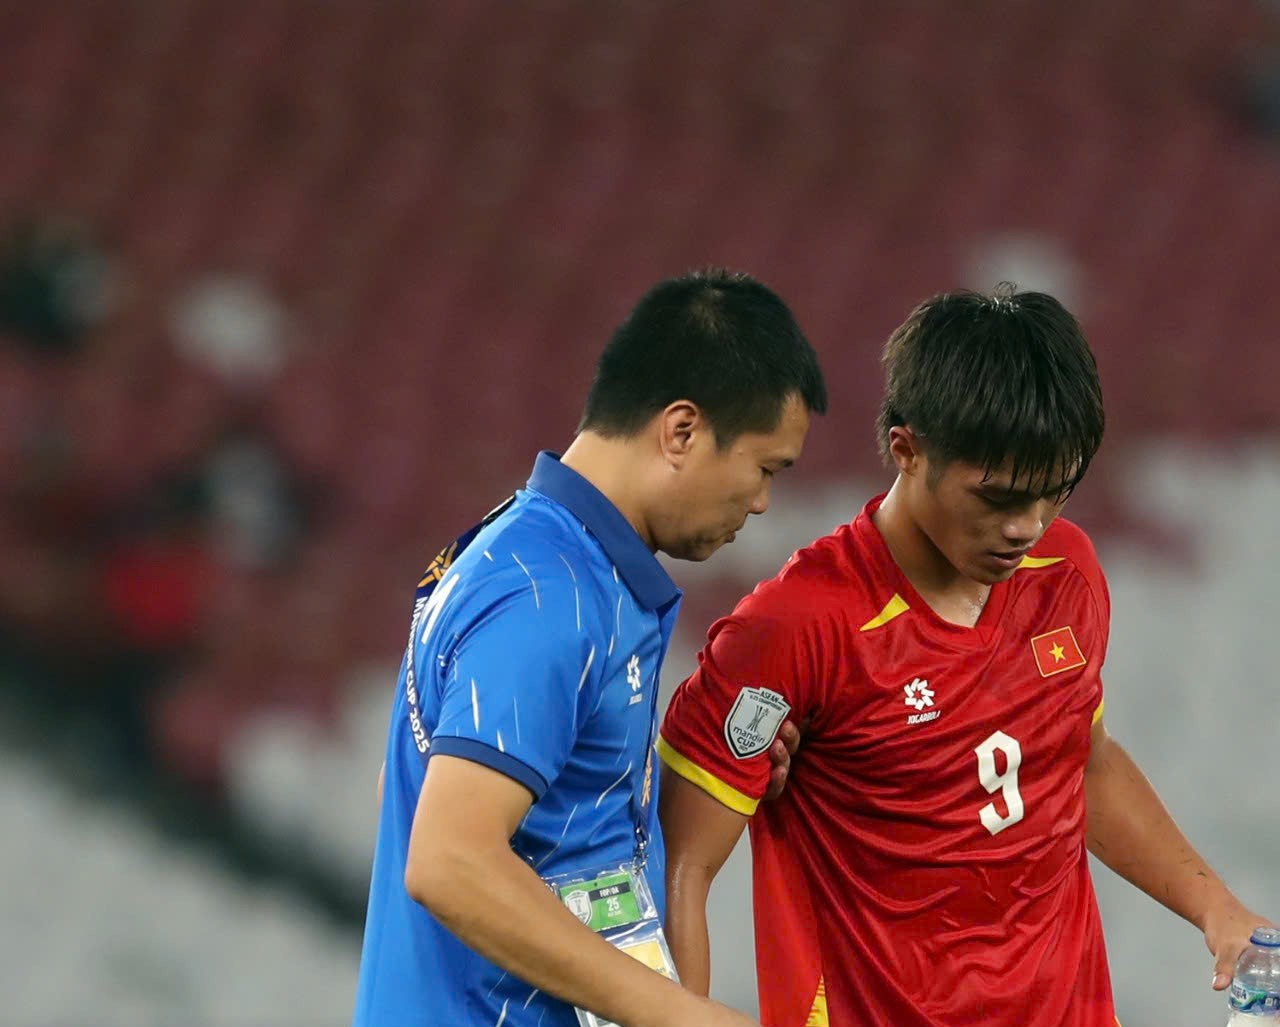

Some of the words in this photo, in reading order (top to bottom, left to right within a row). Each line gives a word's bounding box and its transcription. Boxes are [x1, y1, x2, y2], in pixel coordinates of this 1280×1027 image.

[406, 669, 418, 706] CUP
[409, 707, 431, 753] 2025
[733, 726, 765, 744] mandiri
[737, 736, 756, 748] CUP
[974, 730, 1025, 836] 9
